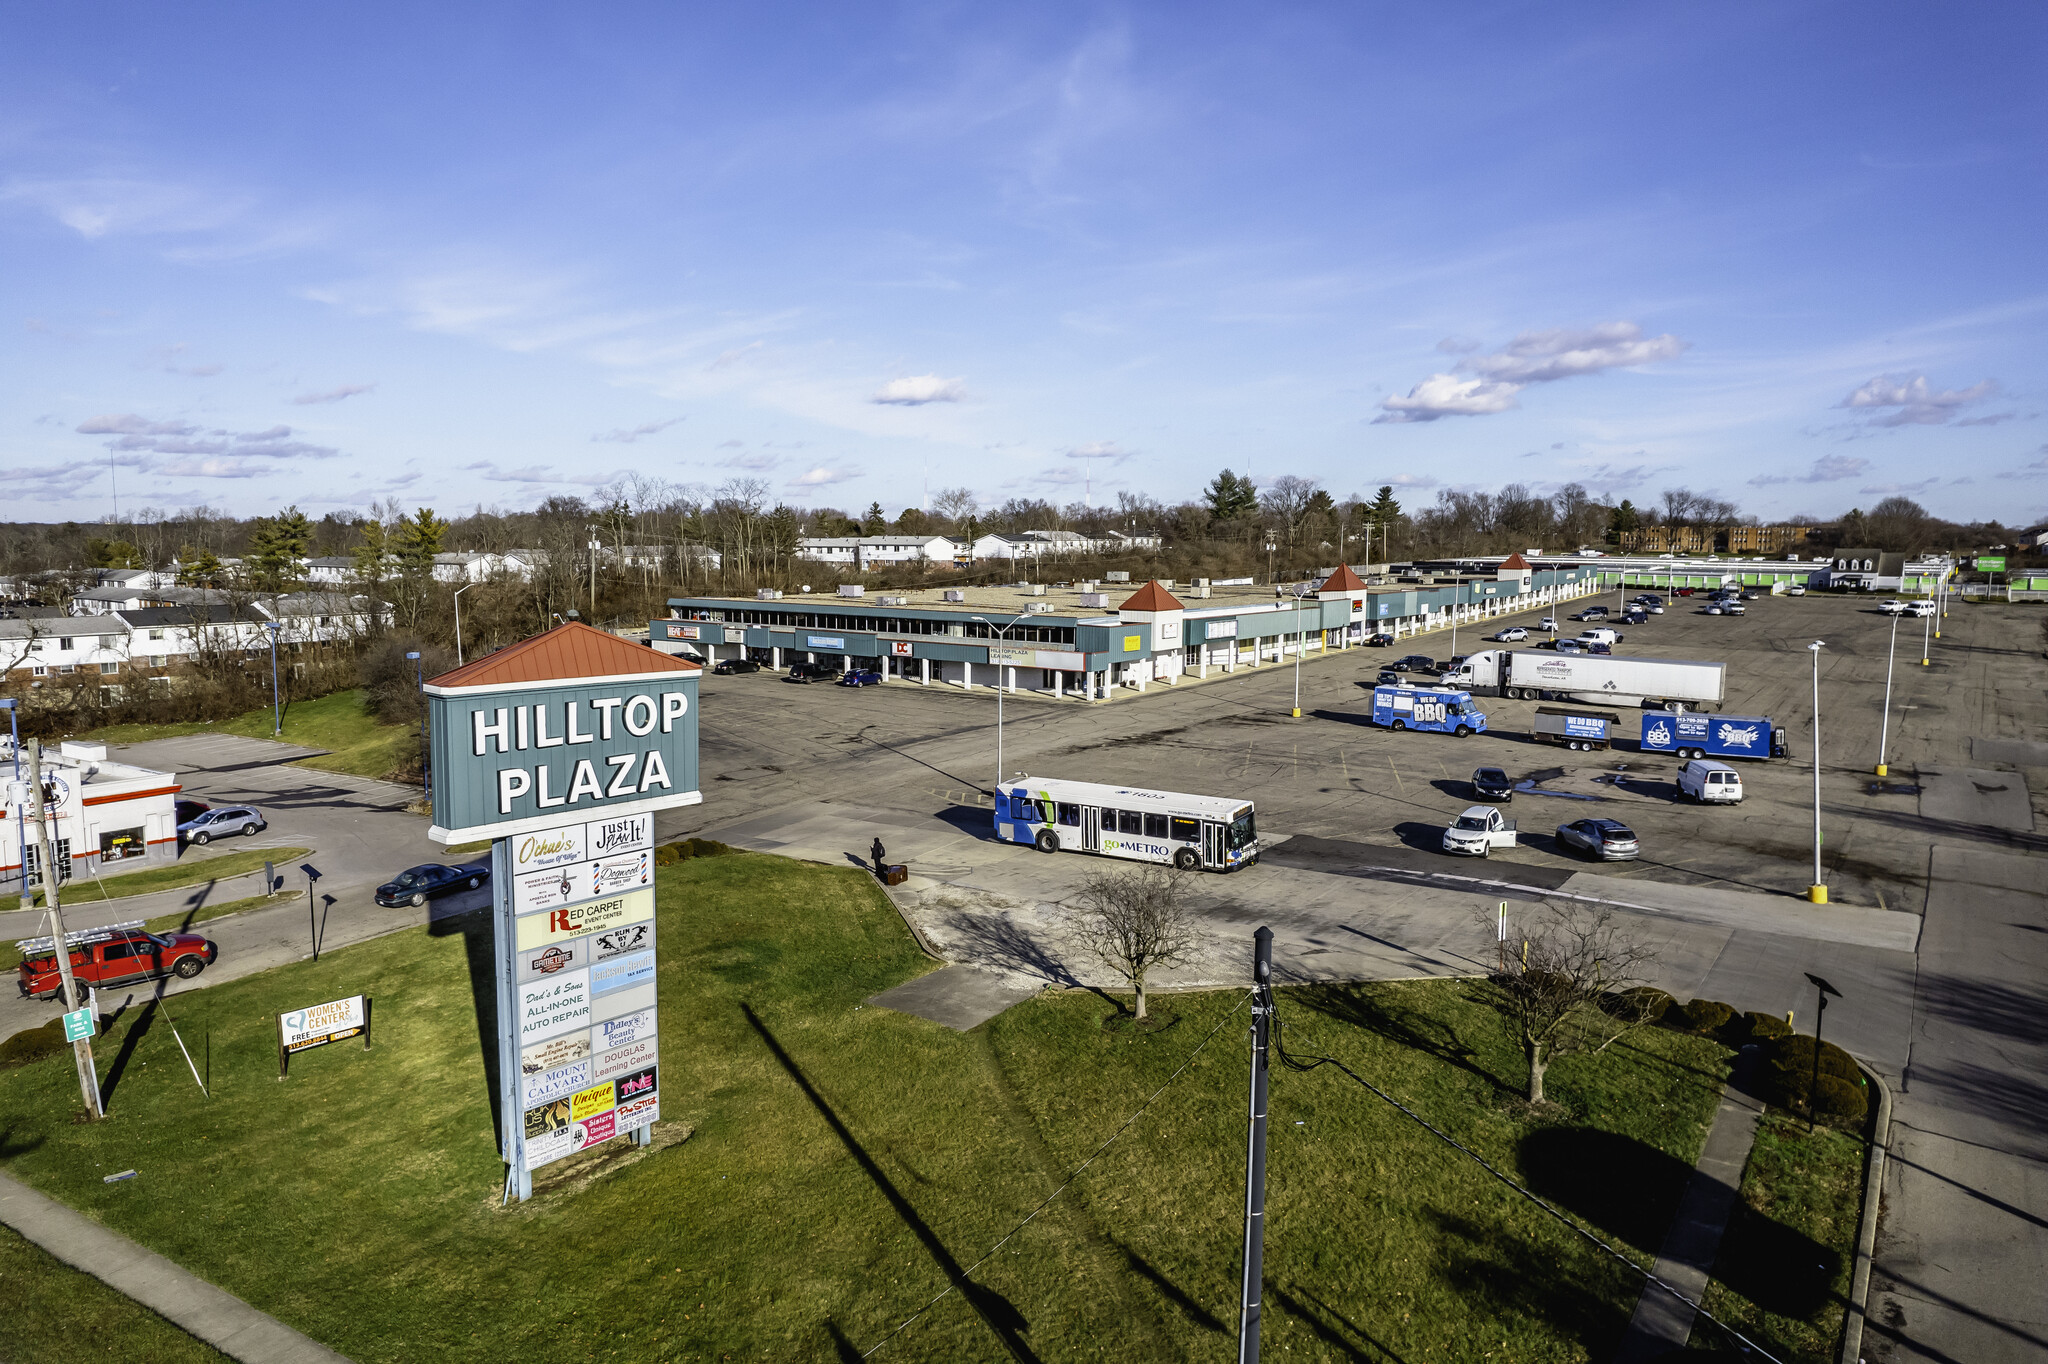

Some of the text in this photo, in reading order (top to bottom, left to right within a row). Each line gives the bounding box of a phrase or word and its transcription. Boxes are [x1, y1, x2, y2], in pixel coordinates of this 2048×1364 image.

[897, 642, 908, 653] DC
[1414, 703, 1446, 723] BBQ
[472, 692, 688, 756] HILLTOP
[1567, 716, 1604, 728] WE DO BBQ
[1647, 730, 1670, 741] BBQ
[1727, 731, 1751, 743] BBQ
[497, 750, 671, 814] PLAZA
[596, 819, 628, 848] Just
[606, 833, 630, 850] PLAN
[1104, 839, 1169, 855] go METRO
[600, 864, 640, 880] Dogwood
[586, 899, 624, 916] CARPET
[584, 911, 622, 924] EVENT CENTER
[614, 928, 630, 937] RUN
[533, 952, 571, 969] GAMETIME
[593, 964, 625, 982] Jackson
[636, 966, 653, 975] SERVICE
[526, 982, 583, 1004] Dad's & Sons
[307, 1000, 350, 1018] WOMEN'S
[527, 994, 584, 1018] ALL-IN-ONE
[308, 1010, 351, 1029] CENTERS
[522, 1006, 589, 1034] AUTO REPAIR
[291, 1031, 311, 1042] FREE
[334, 1029, 354, 1039] OPEN
[608, 1028, 636, 1041] Beauty
[609, 1034, 635, 1047] Center
[548, 1047, 563, 1056] Engine
[604, 1043, 645, 1064] DOUGLAS
[546, 1062, 588, 1082] MOUNT
[595, 1052, 655, 1078] Learning Center
[526, 1080, 590, 1106] APOSTOLIC CHURCH
[528, 1072, 587, 1099] CALVARY
[573, 1086, 612, 1106] Unique
[588, 1114, 613, 1128] Sisters
[621, 1109, 644, 1120] LETTERING
[587, 1129, 615, 1143] Boutique
[590, 1122, 612, 1134] Unique
[528, 1135, 570, 1155] CHILDCARE
